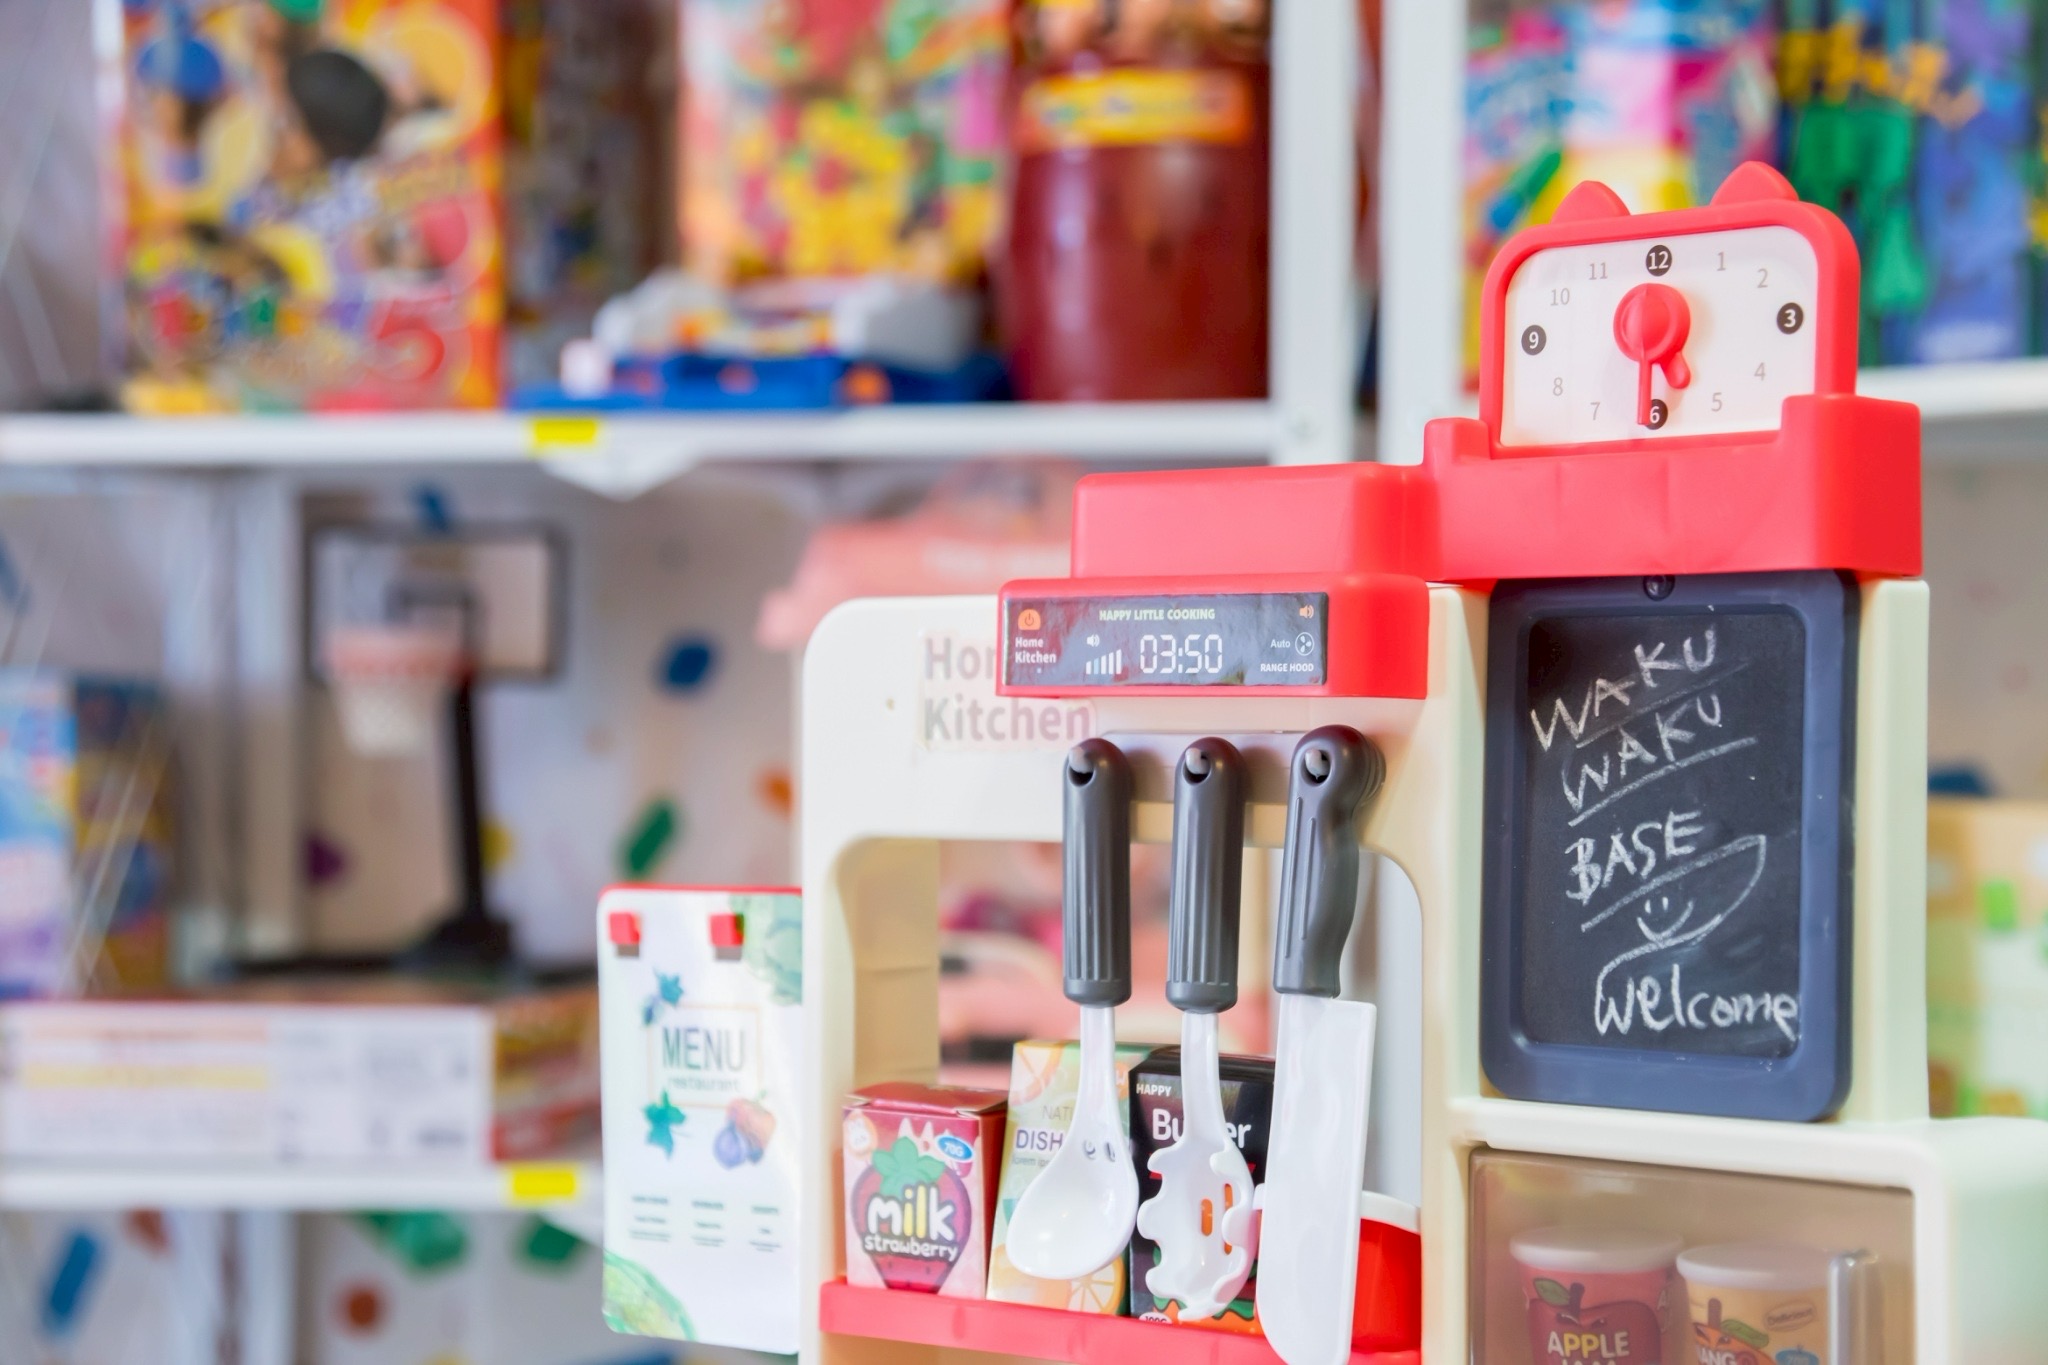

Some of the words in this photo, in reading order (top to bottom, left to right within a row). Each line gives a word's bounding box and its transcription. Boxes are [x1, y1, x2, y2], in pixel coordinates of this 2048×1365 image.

[1648, 250, 1669, 270] 12
[1716, 251, 1727, 271] 1
[1588, 261, 1608, 281] 11
[1756, 268, 1769, 288] 2
[1550, 287, 1570, 306] 10
[1784, 308, 1796, 327] 3
[1529, 331, 1539, 349] 9
[1753, 362, 1766, 381] 4
[1552, 377, 1564, 397] 8
[1590, 402, 1601, 420] 7
[1711, 392, 1723, 412] 5
[1650, 405, 1660, 424] 6
[1099, 609, 1131, 621] HAPPY
[1134, 609, 1164, 621] LITTLE
[1167, 608, 1215, 620] COOKING
[1015, 637, 1044, 648] Home
[1270, 639, 1291, 648] Auto
[925, 637, 996, 680] Ho
[1015, 651, 1057, 663] Kitchen
[1140, 634, 1222, 674] 03:50
[1260, 663, 1288, 672] RANGE
[1289, 662, 1314, 672] HOOD
[1530, 627, 1716, 751] WAKU
[924, 694, 1090, 741] Kitchen
[1561, 694, 1721, 813] WAKU
[1565, 810, 1704, 906] BASE
[663, 1026, 744, 1071] MENU
[1136, 1083, 1172, 1097] HAPPY
[1152, 1108, 1252, 1149] Buer
[864, 1234, 958, 1262] strawberry
[1548, 1331, 1630, 1359] APPLE
